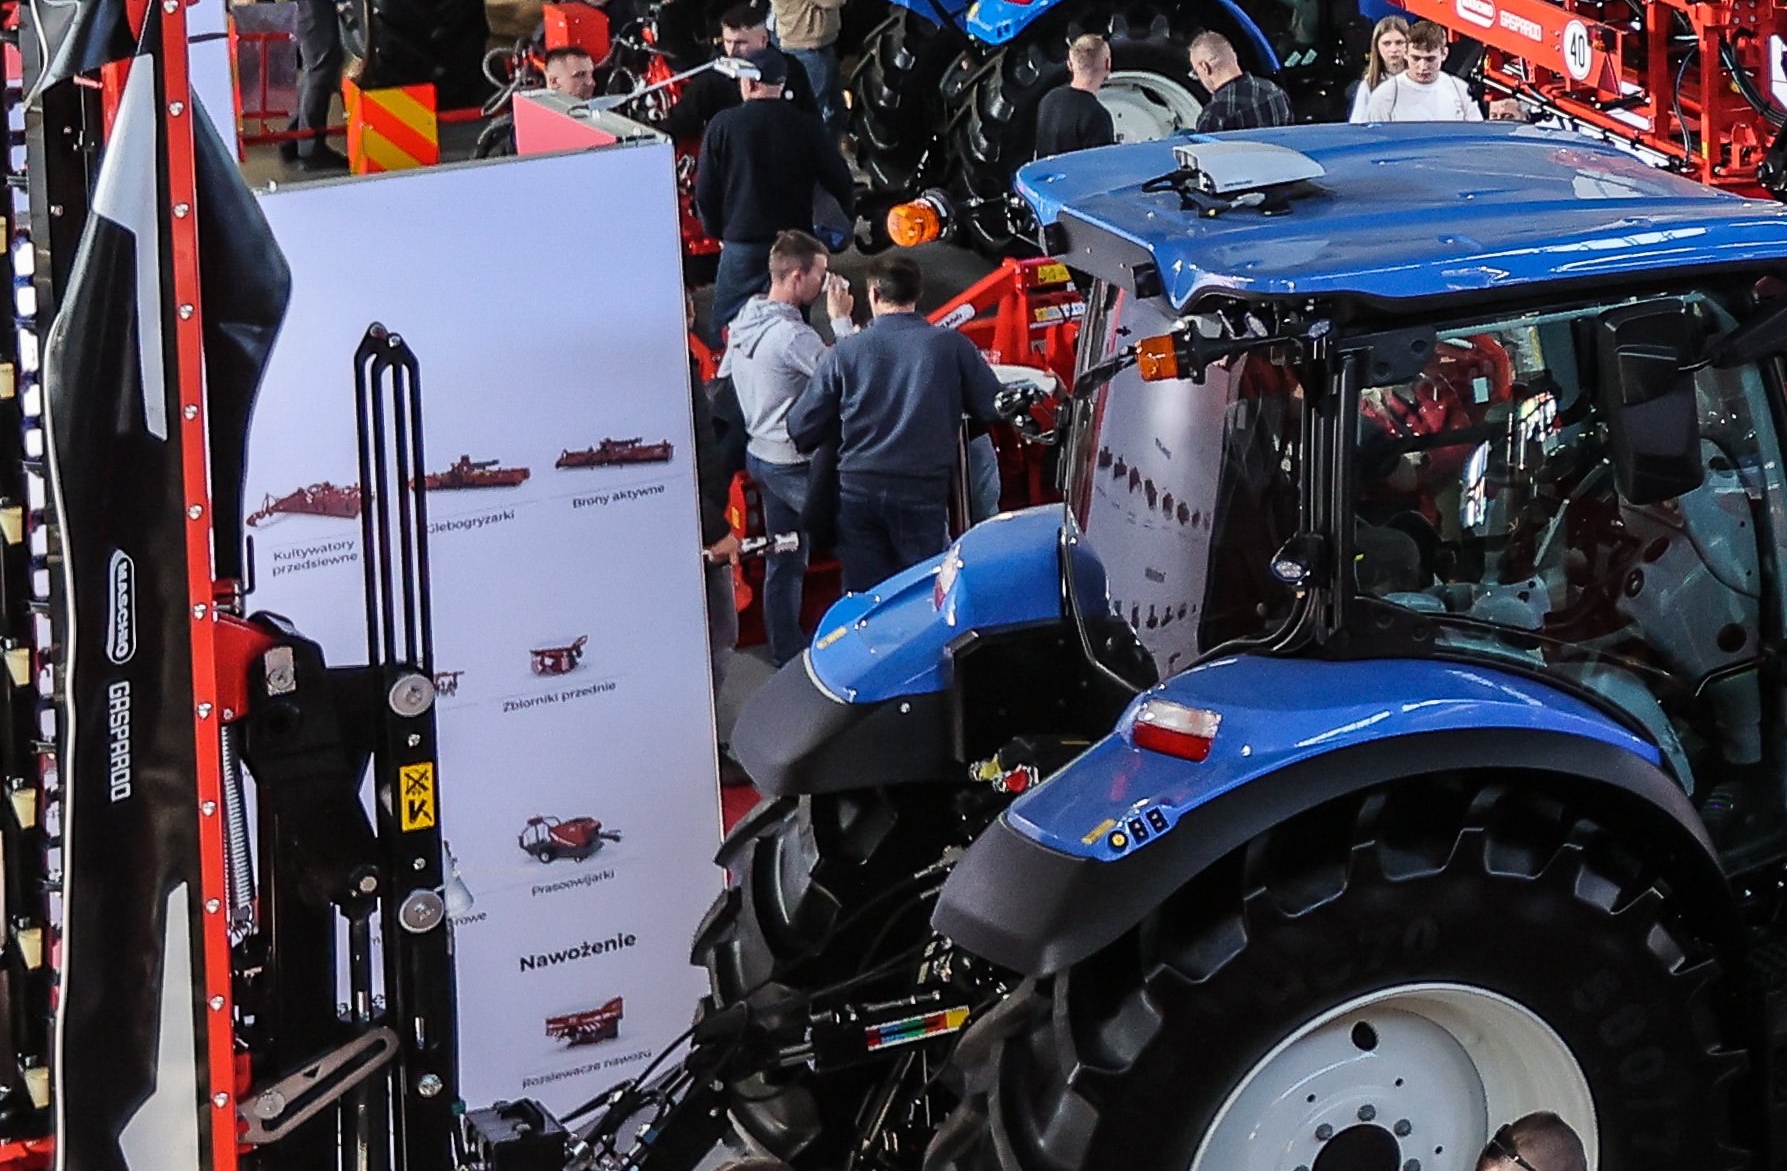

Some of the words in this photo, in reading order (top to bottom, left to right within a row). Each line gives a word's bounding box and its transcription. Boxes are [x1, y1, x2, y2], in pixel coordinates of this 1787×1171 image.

[1500, 10, 1542, 41] GASPARDO
[1569, 33, 1585, 69] 40
[572, 493, 609, 510] Brony
[612, 484, 665, 503] aktywne
[273, 539, 355, 562] Kultywatory
[503, 694, 559, 713] Zbiorniki
[561, 681, 617, 702] przednie
[109, 680, 131, 803] GASPARDO
[519, 931, 637, 972] Nawożenie
